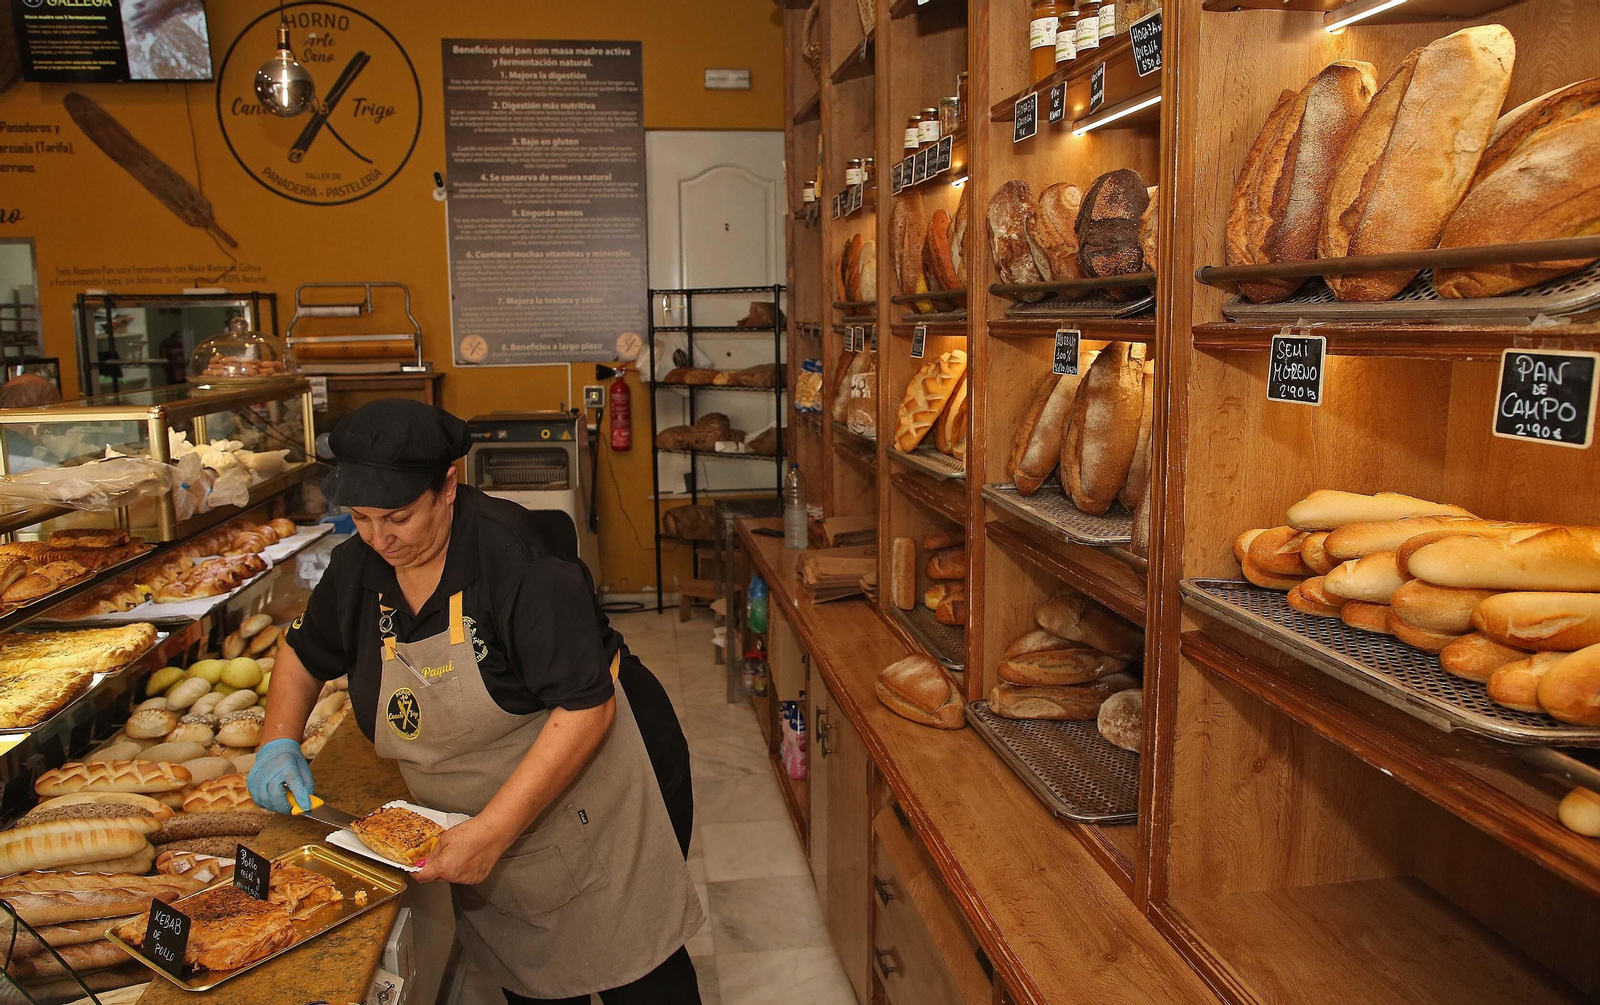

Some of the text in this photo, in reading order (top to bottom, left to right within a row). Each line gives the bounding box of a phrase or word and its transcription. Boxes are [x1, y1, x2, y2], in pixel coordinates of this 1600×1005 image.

[284, 12, 350, 31] HORNO
[301, 48, 335, 63] Sano
[452, 45, 498, 54] Beneficios
[499, 45, 514, 54] del
[515, 46, 532, 56] pan
[534, 47, 550, 55] con
[575, 46, 604, 55] madre
[604, 46, 631, 56] activa
[492, 58, 593, 68] y fermentación natural.
[500, 71, 587, 80] 1. Mejora la digestión
[352, 97, 397, 124] Trigo
[492, 102, 596, 111] 2. Digestión más nutritiva
[0, 121, 60, 135] Panaderos y
[512, 138, 520, 146] 3.
[520, 138, 539, 147] Bajo
[552, 138, 579, 147] gluten
[0, 164, 37, 173] errano.
[262, 166, 317, 198] PANADERÍA
[326, 168, 383, 198] PASTELERÍA
[305, 172, 331, 180] TALLER
[501, 174, 538, 182] conserva
[539, 174, 550, 182] de
[550, 174, 582, 182] manera
[582, 173, 612, 182] natural
[521, 209, 556, 218] Engorda
[475, 250, 512, 259] Contiene
[513, 250, 544, 259] muchas
[546, 250, 584, 259] vitaminas
[592, 250, 631, 259] minerales
[506, 297, 535, 306] Mejora
[510, 343, 551, 351] Beneficios
[558, 343, 580, 352] largo
[581, 343, 602, 352] plazo
[1273, 362, 1318, 382] MORENO
[1516, 355, 1571, 385] PAN
[1532, 383, 1548, 396] DE
[1501, 392, 1577, 422] CAMPO
[421, 660, 455, 678] Paqui
[240, 849, 258, 870] Pollo
[240, 869, 254, 882] miel
[154, 910, 182, 935] KEBAB
[152, 929, 162, 940] DE
[154, 943, 175, 962] POLLO
